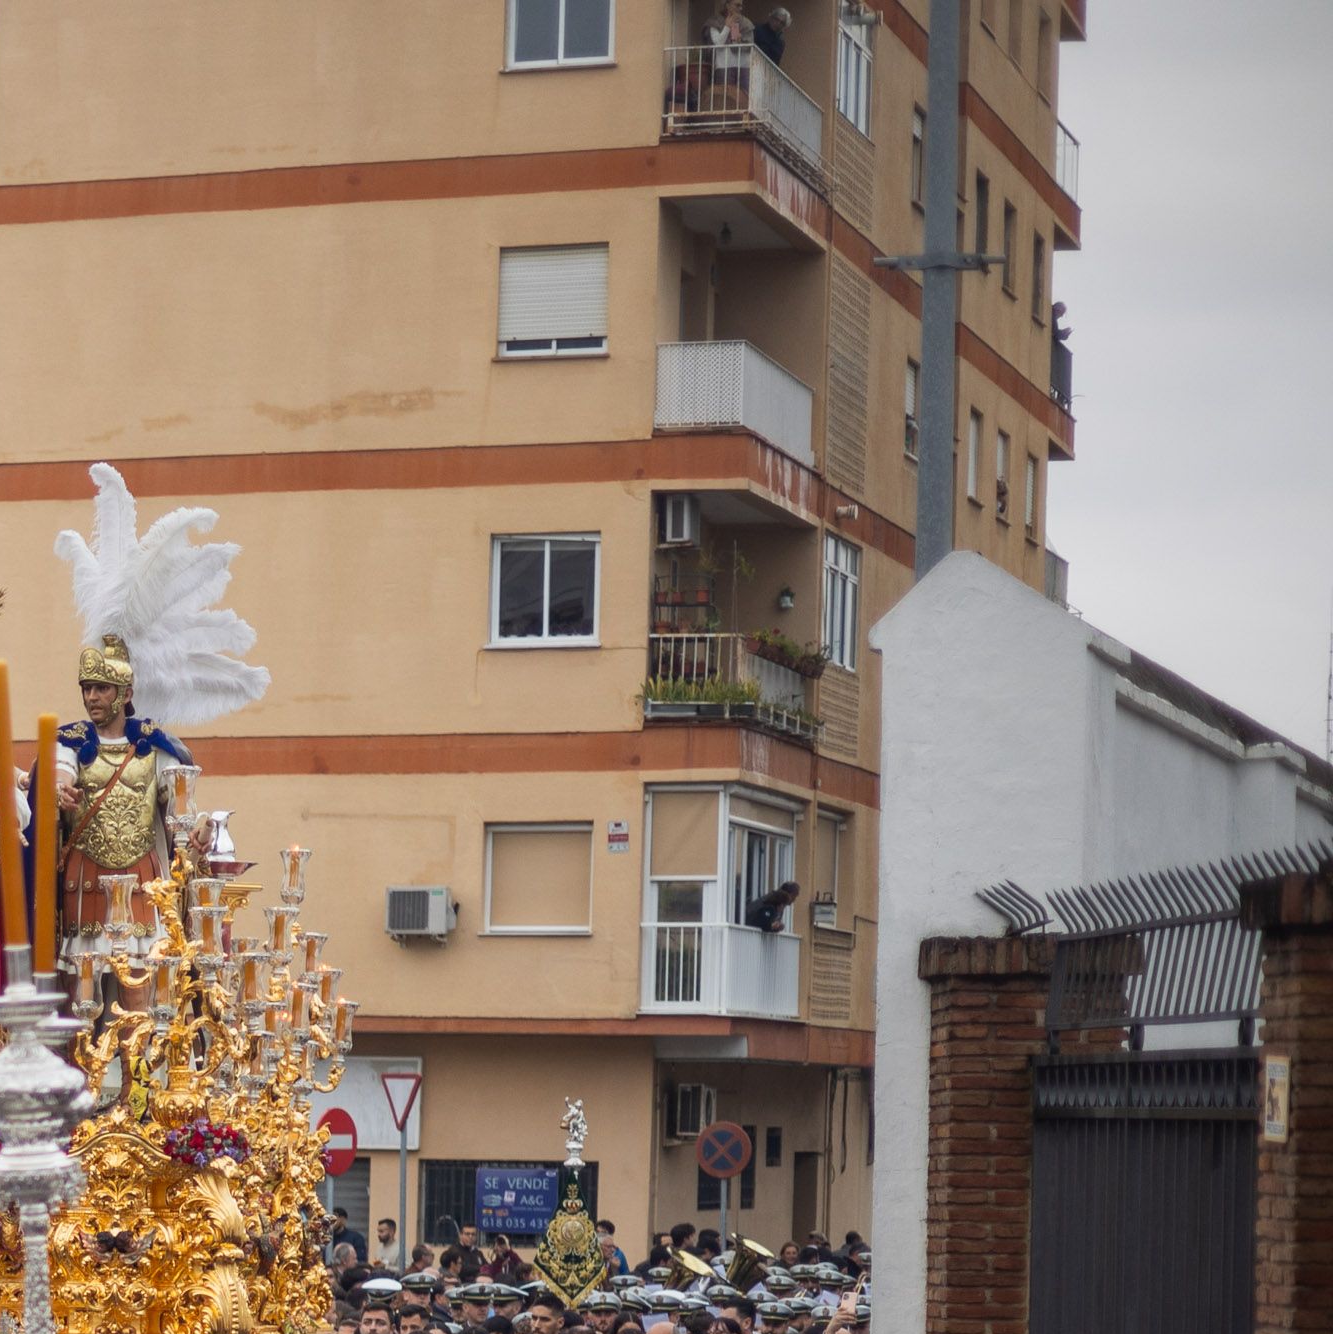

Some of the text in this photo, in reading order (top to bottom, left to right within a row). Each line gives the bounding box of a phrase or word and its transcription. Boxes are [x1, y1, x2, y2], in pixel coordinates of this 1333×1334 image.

[484, 1177, 550, 1190] SE VENDE
[520, 1195, 544, 1205] A&G
[482, 1217, 502, 1228] 618
[505, 1217, 526, 1228] 035
